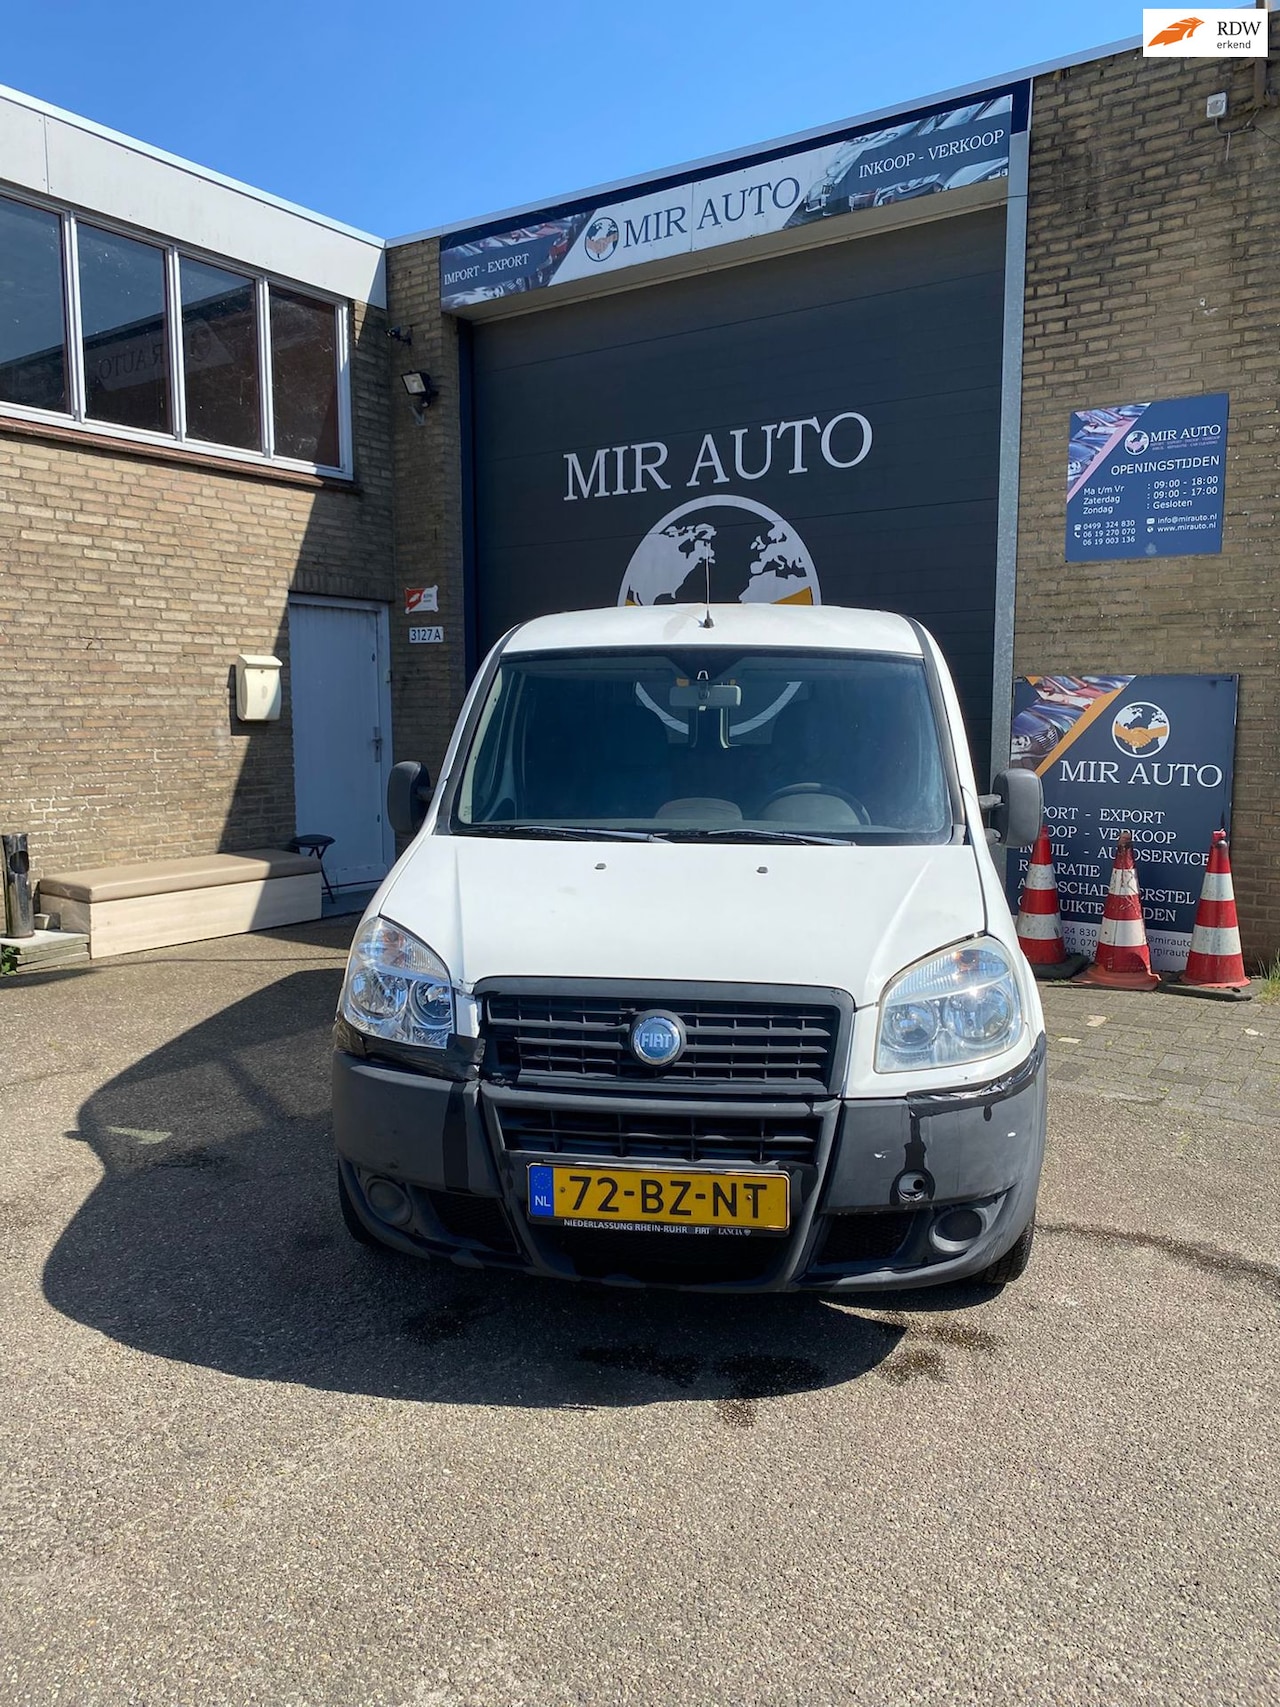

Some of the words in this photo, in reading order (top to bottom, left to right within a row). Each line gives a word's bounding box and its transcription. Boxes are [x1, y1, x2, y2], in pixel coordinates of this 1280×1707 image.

[858, 152, 916, 178] INKOOP
[927, 129, 1004, 161] VERKOOP
[623, 206, 688, 248] MIR
[696, 177, 800, 231] AUTO
[444, 265, 480, 286] IMPORT
[487, 253, 530, 273] EXPORT
[1150, 430, 1177, 442] MIR
[1180, 424, 1221, 439] AUTO
[563, 441, 672, 501] MIR
[686, 411, 873, 487] AUTO
[1111, 455, 1220, 476] OPENINGSTIJDEN
[1098, 486, 1112, 495] t/m
[1153, 479, 1180, 489] 09:00
[1192, 475, 1218, 486] 18:00
[1083, 496, 1120, 505] Zaterdag
[1153, 489, 1180, 499] 09:00
[1191, 486, 1218, 496] 17:00
[1083, 506, 1113, 515] Zondag
[1153, 499, 1193, 509] Gesloten
[1083, 522, 1101, 530] 0499
[1157, 513, 1217, 524] info@mirauto.nl
[1157, 522, 1216, 532] www.mirauto.nl
[1059, 760, 1120, 783] MIR
[1128, 762, 1223, 787] AUTO
[1100, 808, 1166, 824] EXPORT
[1048, 824, 1078, 838] OOP
[1097, 846, 1210, 866] AUOSERVICE
[1018, 859, 1101, 878] RRATIE
[1064, 926, 1075, 934] 24
[1079, 928, 1097, 937] 830
[1080, 939, 1098, 948] 070
[641, 1032, 671, 1048] FIAT
[534, 1195, 551, 1208] NL
[569, 1175, 768, 1219] 72-BZ-NT
[563, 1219, 633, 1231] NIEDERLASSUNG
[634, 1223, 688, 1234] RHEIN-RUHR
[694, 1227, 710, 1235] FIAT
